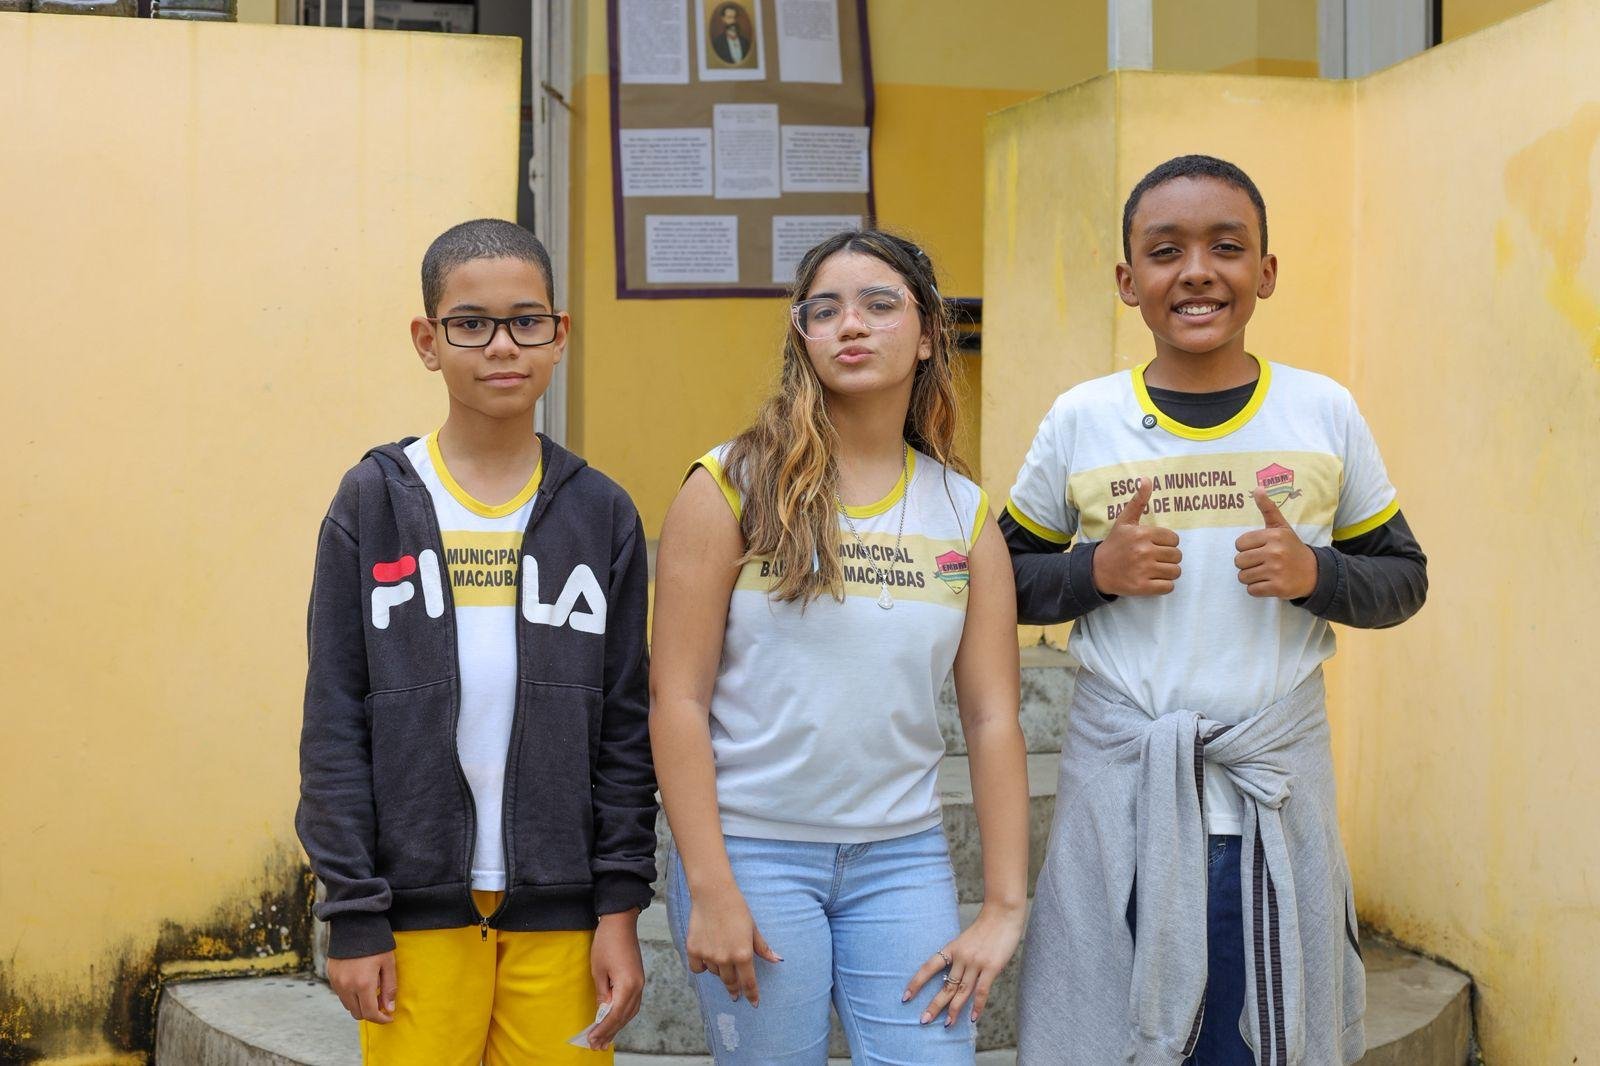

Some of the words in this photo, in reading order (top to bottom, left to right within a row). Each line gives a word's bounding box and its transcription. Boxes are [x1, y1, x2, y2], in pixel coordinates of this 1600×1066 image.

[1110, 475, 1161, 497] ESCOA
[1164, 470, 1236, 489] MUNICIPAL
[1152, 497, 1171, 513] DE
[1173, 492, 1245, 513] MACAUBAS
[453, 569, 519, 587] MACAUB
[843, 565, 926, 589] MACAUBAS
[371, 548, 608, 635] FILA
